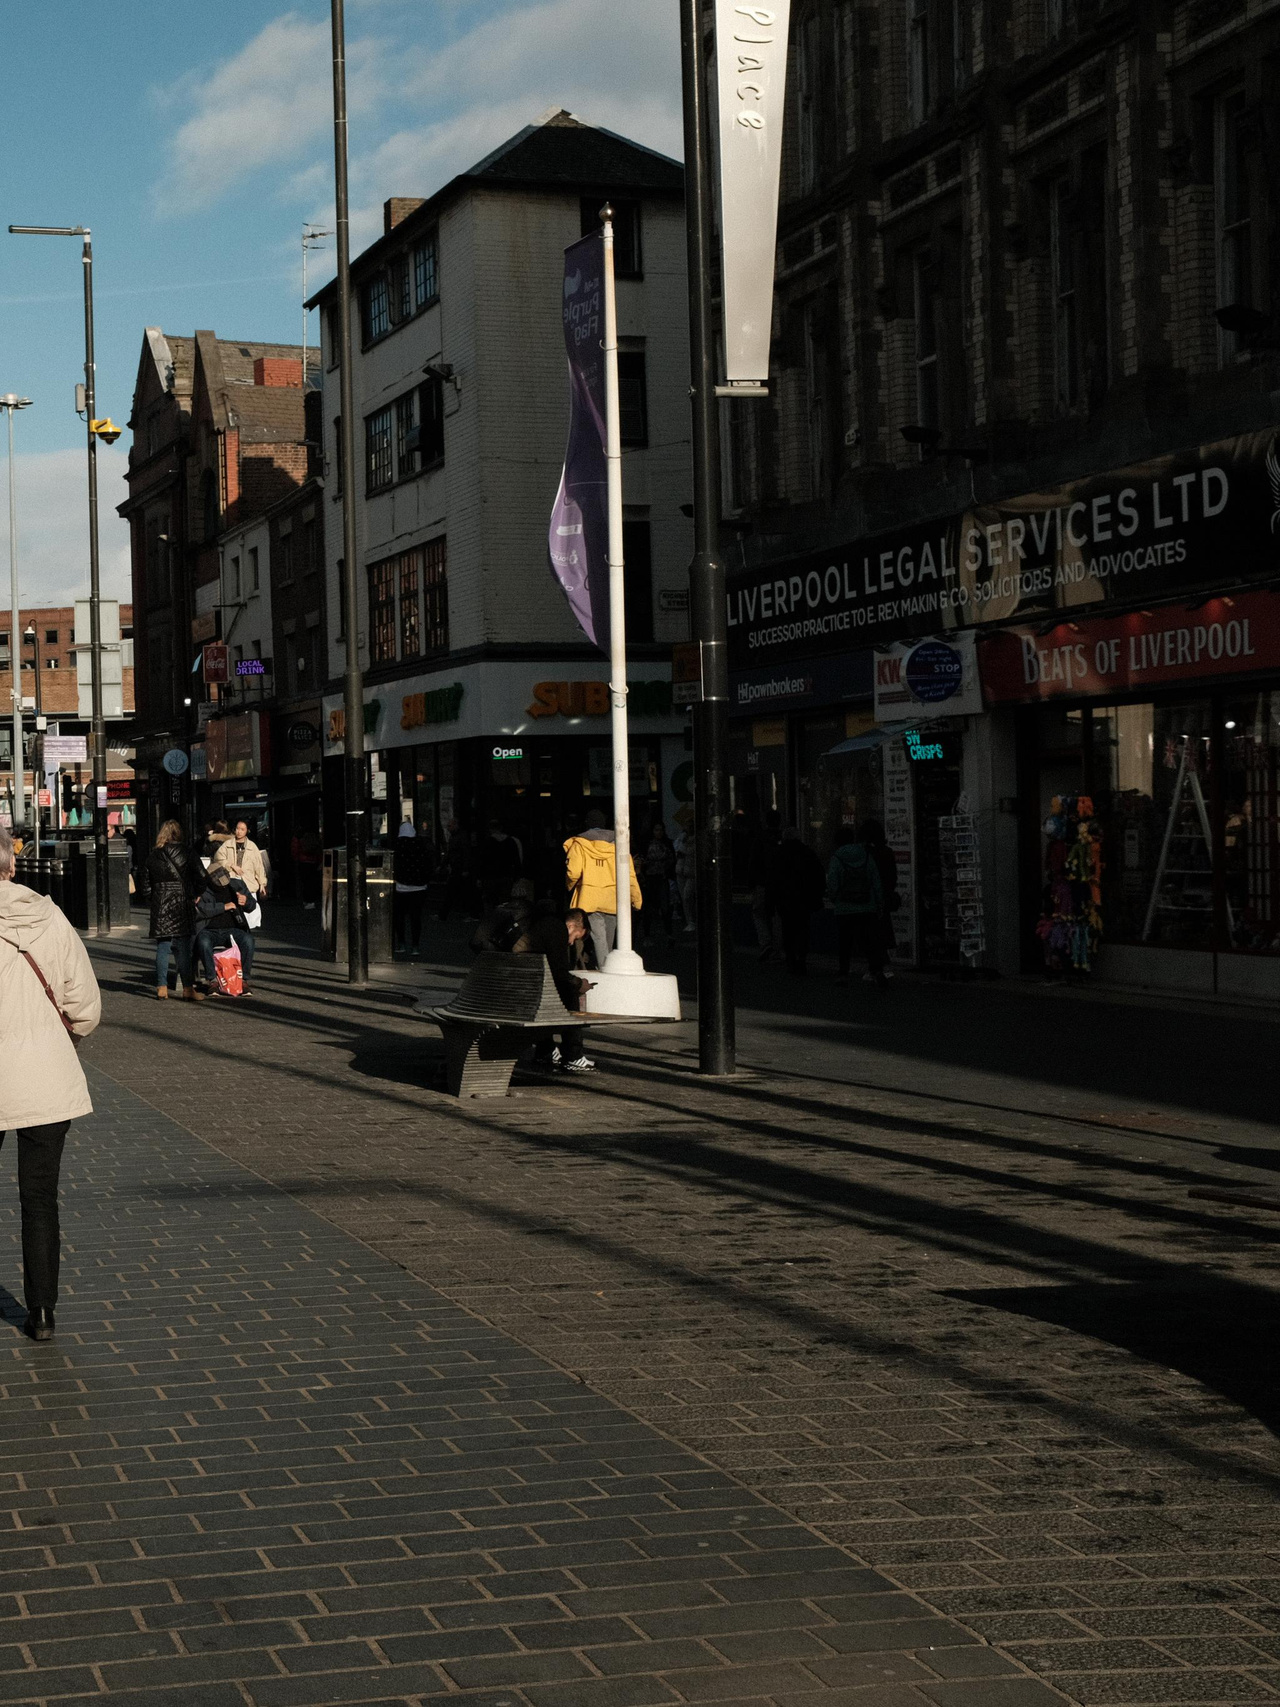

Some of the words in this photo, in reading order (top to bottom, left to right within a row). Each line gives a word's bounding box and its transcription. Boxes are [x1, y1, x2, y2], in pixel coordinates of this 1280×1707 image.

[726, 561, 857, 628] LIVERPOOL
[863, 537, 956, 596] LEGAL
[964, 487, 1140, 572] SERVICES
[1152, 466, 1230, 530] LTD
[748, 621, 803, 650] SUCCESSOR
[803, 611, 851, 640] PRACTICE
[851, 607, 866, 629] TO
[878, 601, 899, 622] REX
[901, 594, 938, 617] MAKIN
[939, 591, 948, 609] &
[973, 567, 1053, 601] SOLICITORS
[1054, 560, 1086, 587] AND
[1088, 538, 1188, 580] ADVOCATES
[1021, 634, 1088, 689] BEATS
[1095, 638, 1121, 675] OF
[1129, 618, 1255, 671] LIVERPOOL
[236, 666, 266, 676] DRINK
[237, 660, 263, 668] LOCAL
[934, 663, 960, 673] STOP
[108, 738, 129, 757] ONG
[492, 746, 523, 759] Open
[909, 743, 944, 760] CRISPS
[172, 775, 180, 805] AIRS
